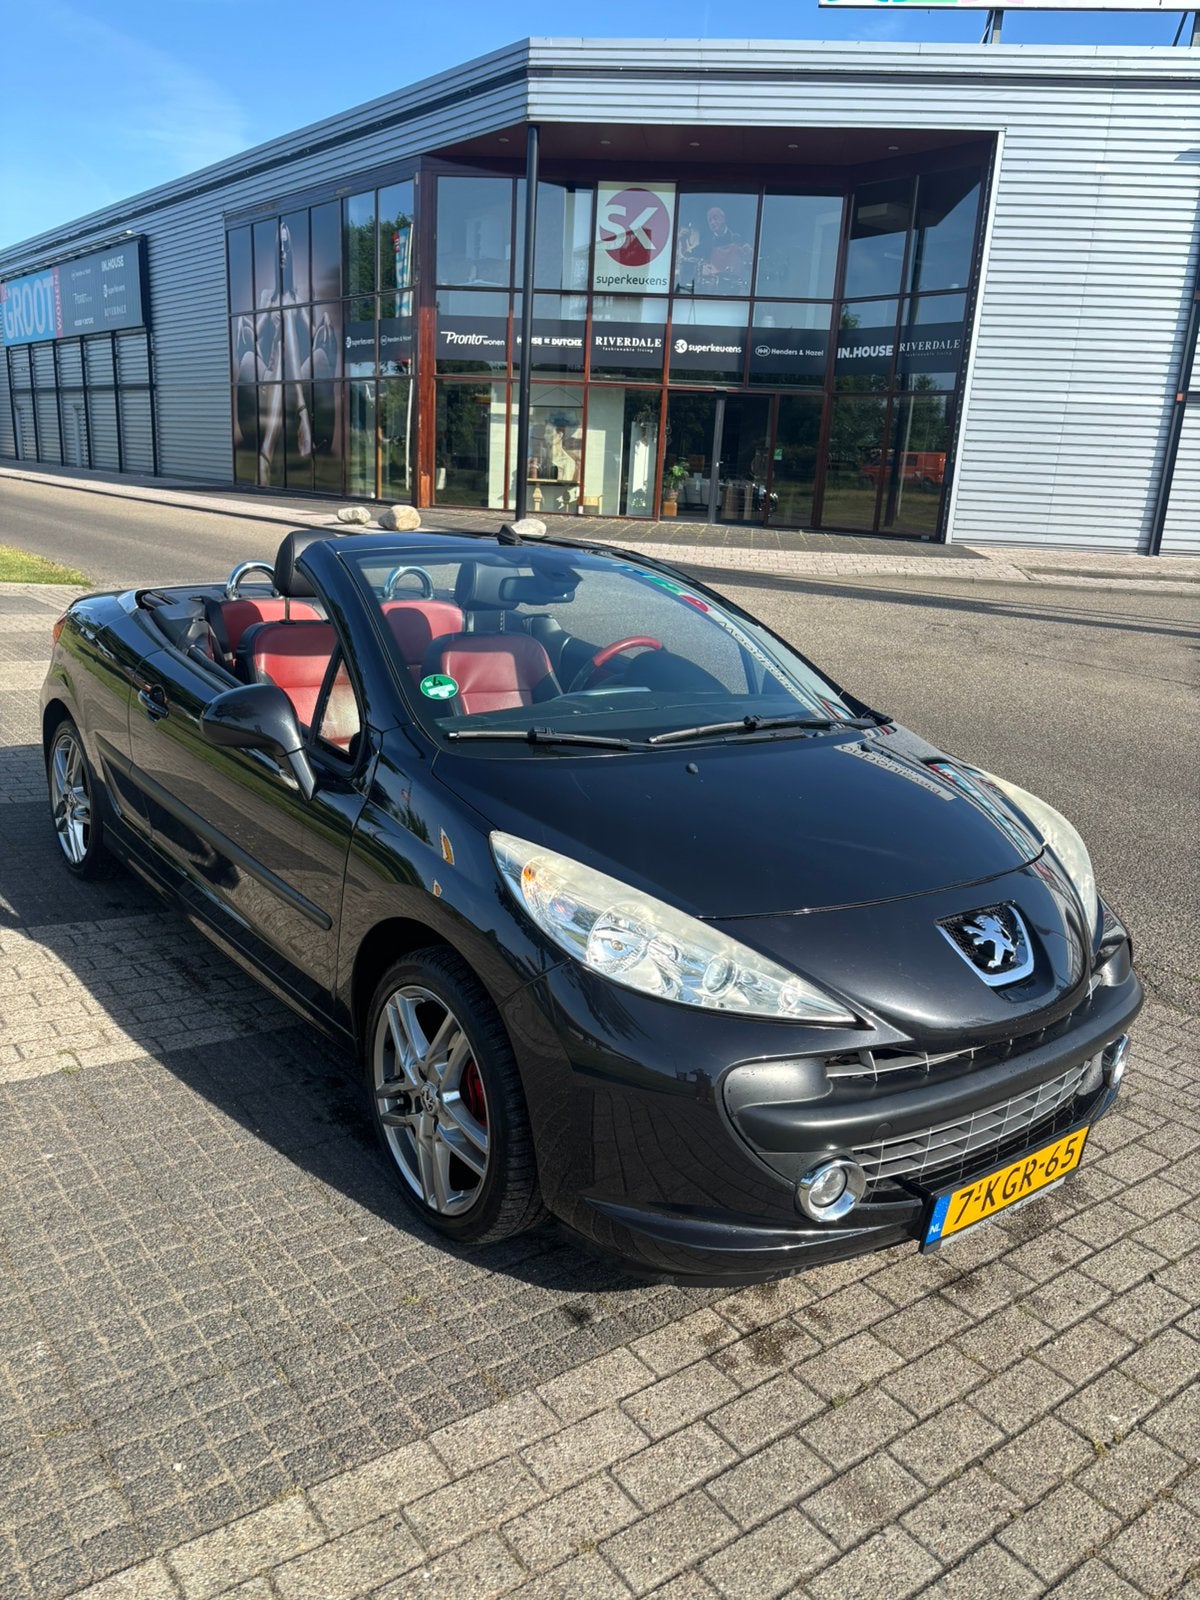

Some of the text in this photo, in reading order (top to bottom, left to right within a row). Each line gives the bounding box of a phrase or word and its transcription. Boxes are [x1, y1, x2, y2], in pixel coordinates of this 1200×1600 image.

[440, 331, 488, 345] Pronto
[517, 336, 542, 346] HSE
[595, 336, 662, 348] RIVERDALE
[899, 339, 960, 352] RIVERDALE
[771, 348, 798, 356] Henders
[837, 345, 893, 359] IN.HOUSE
[953, 1136, 1079, 1225] 7-KGR-65
[928, 1223, 941, 1235] NL
